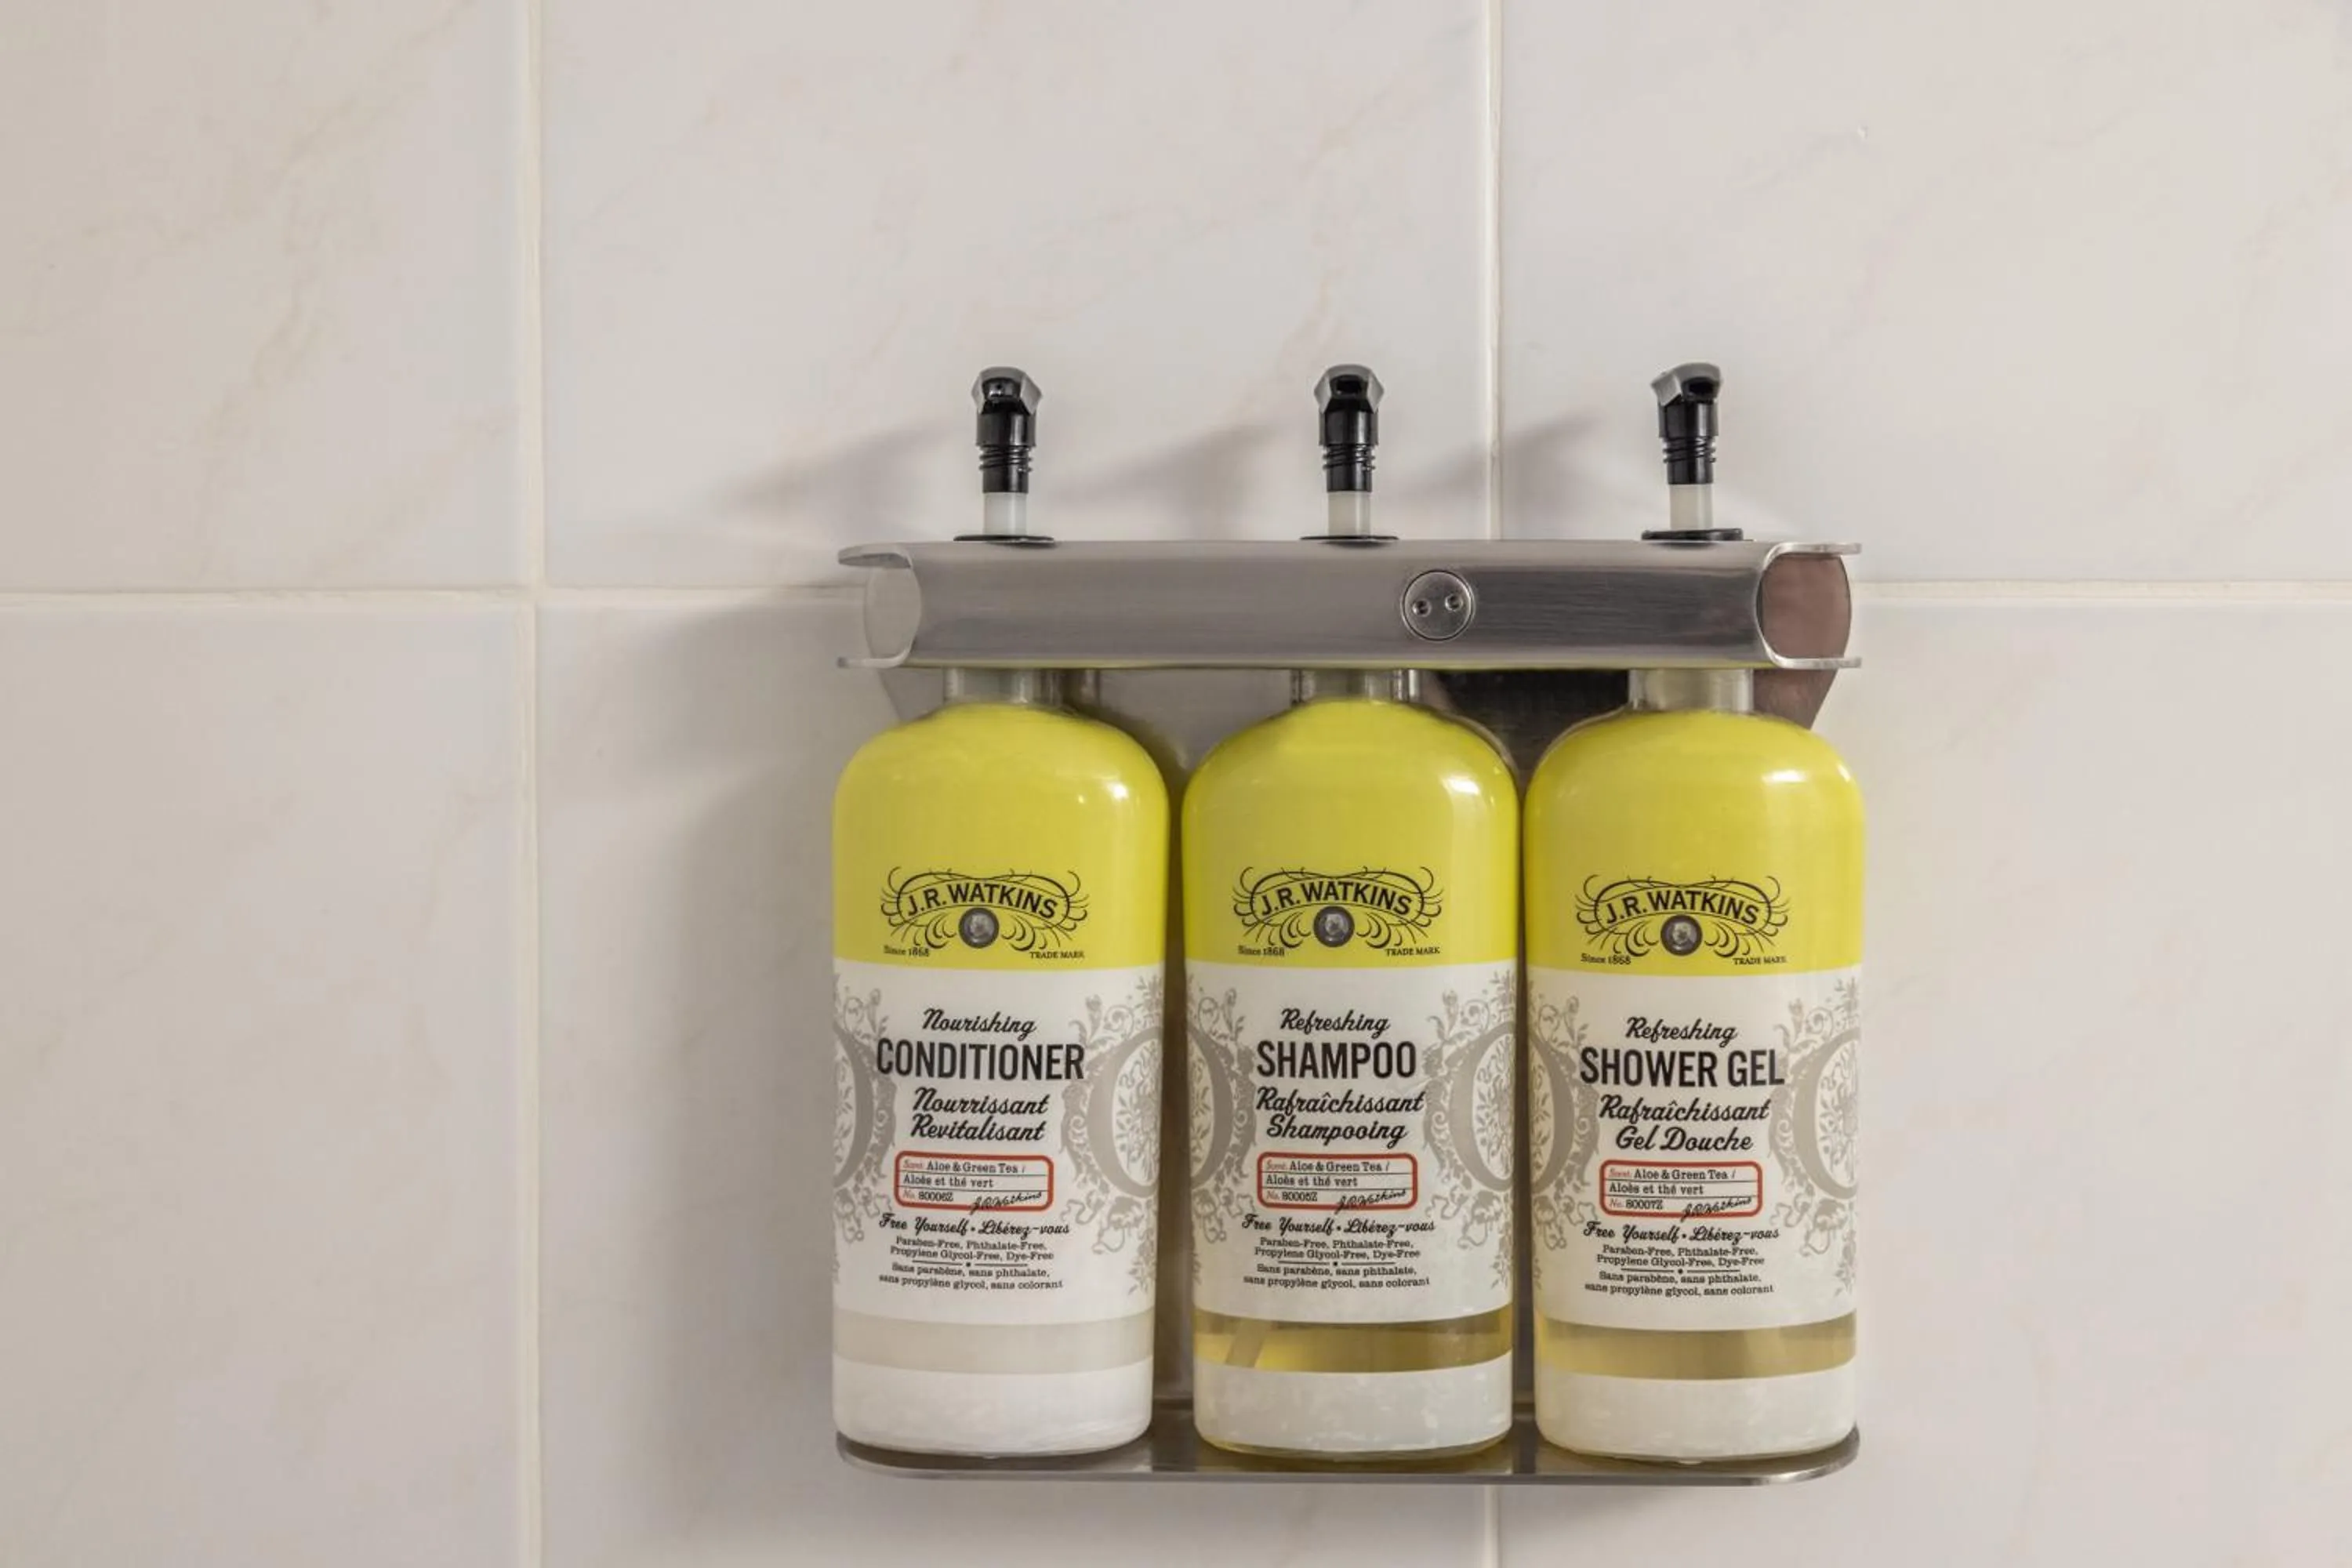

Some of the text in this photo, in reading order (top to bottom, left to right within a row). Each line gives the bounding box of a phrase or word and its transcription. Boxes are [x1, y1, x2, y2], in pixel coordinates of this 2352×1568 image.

[948, 883, 1058, 920] WATKINS
[1301, 880, 1413, 916] WATKINS
[1647, 891, 1760, 925] WATKINS
[1385, 948, 1414, 956] TRADE
[1733, 956, 1761, 965] TRADE
[922, 1007, 1036, 1041] Nourishing
[1279, 1007, 1391, 1039] Refreshing
[1626, 1017, 1738, 1047] Refreshing
[877, 1037, 1084, 1080] CONDITIONER
[1257, 1040, 1417, 1080] SHAMPOO
[1580, 1047, 1785, 1087] SHOWER GEL
[913, 1087, 1051, 1115] Nourrissant
[1256, 1087, 1427, 1116] Rafraîchissant
[1599, 1094, 1771, 1123] Rafraîchissant
[910, 1113, 1047, 1141] Revitalisant
[1266, 1114, 1408, 1149] Shampooing
[1616, 1125, 1753, 1151] Gel Douche
[927, 1161, 951, 1171] Aloe
[953, 1163, 962, 1172] &
[963, 1163, 996, 1173] Green
[999, 1163, 1018, 1174] Tea
[1290, 1162, 1313, 1171] Aloe
[1316, 1162, 1324, 1171] &
[1326, 1162, 1359, 1171] Green
[1363, 1163, 1382, 1171] Tea
[1634, 1170, 1660, 1179] Aloe
[1661, 1171, 1670, 1180] &
[1671, 1170, 1706, 1180] Green
[1708, 1170, 1728, 1179] Tea
[903, 1174, 932, 1185] Aloès
[935, 1177, 946, 1185] et
[949, 1175, 967, 1187] thé
[1266, 1175, 1294, 1185] Aloès
[1312, 1176, 1330, 1186] thé
[1334, 1178, 1358, 1187] vert
[1609, 1183, 1704, 1195] Aloès et thé vert
[879, 1212, 1070, 1240] Free Yourself Libérez-vous
[1242, 1214, 1436, 1238] Free Yourself Libérez-vous
[1583, 1221, 1780, 1244] Free Yourself Libérez-vous
[891, 1245, 938, 1258] Propylene
[1006, 1251, 1054, 1262] Dye-Free
[1255, 1247, 1304, 1258] Propylene
[1374, 1249, 1421, 1261] Dye-Free
[1597, 1254, 1649, 1265] Propylene
[1718, 1257, 1765, 1268] Dye-Free
[1018, 1280, 1063, 1290] colorant
[1386, 1276, 1429, 1287] colorant
[1730, 1285, 1773, 1295] colorant
